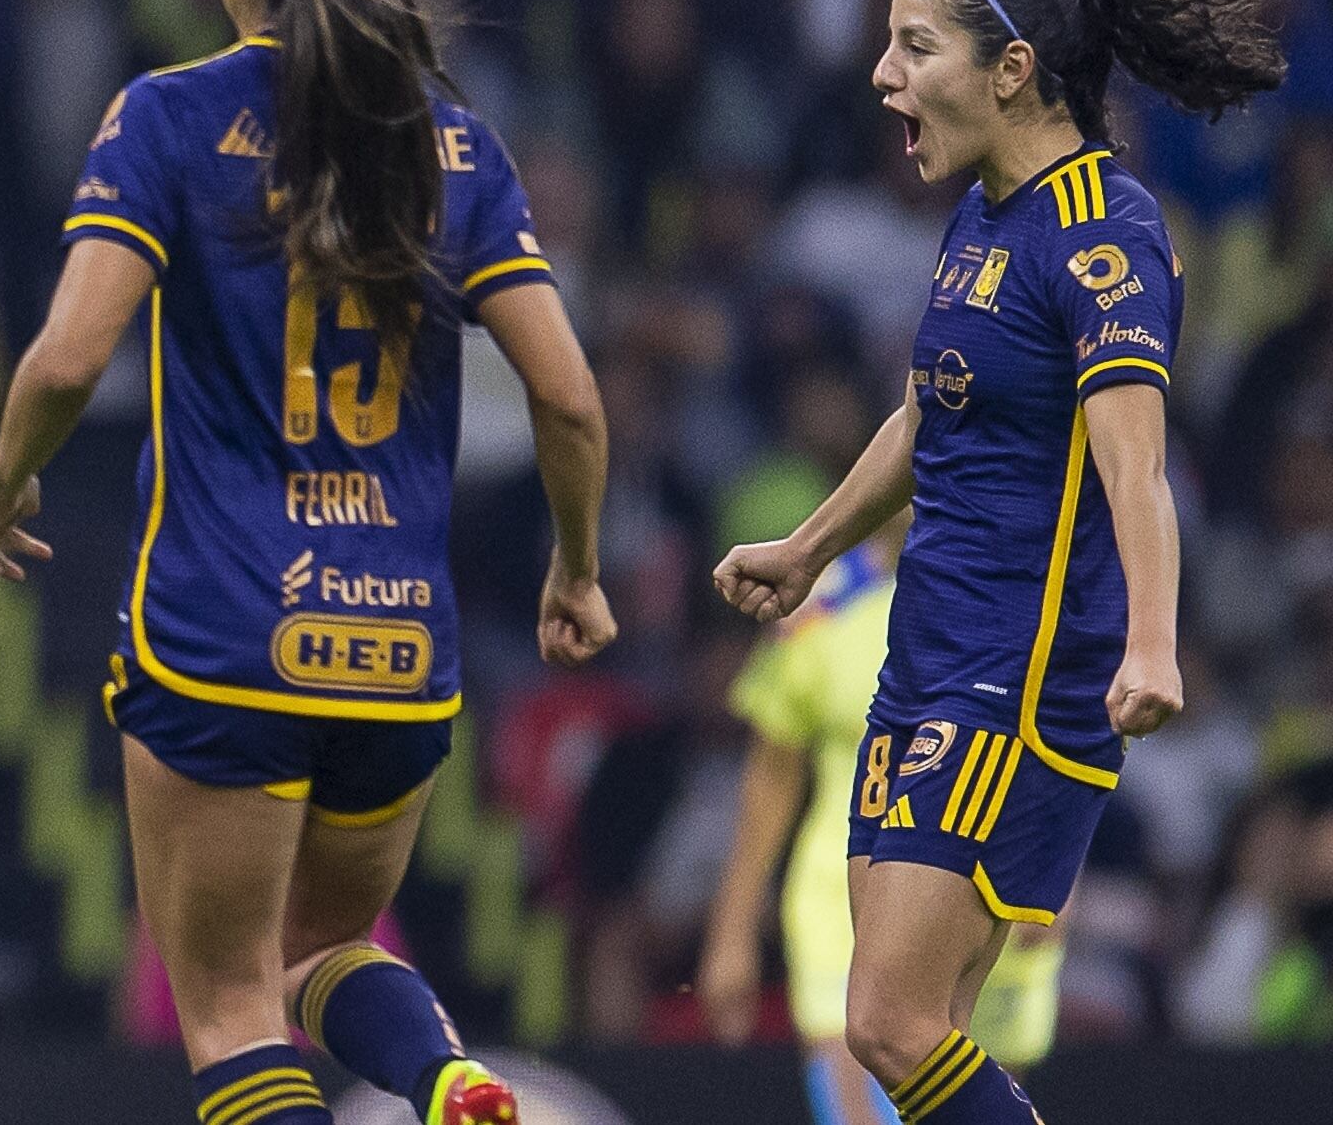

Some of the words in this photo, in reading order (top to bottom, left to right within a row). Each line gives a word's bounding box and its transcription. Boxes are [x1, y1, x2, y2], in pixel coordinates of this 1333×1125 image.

[1095, 274, 1144, 311] Berel
[320, 566, 432, 607] Futura
[860, 734, 892, 818] 8
